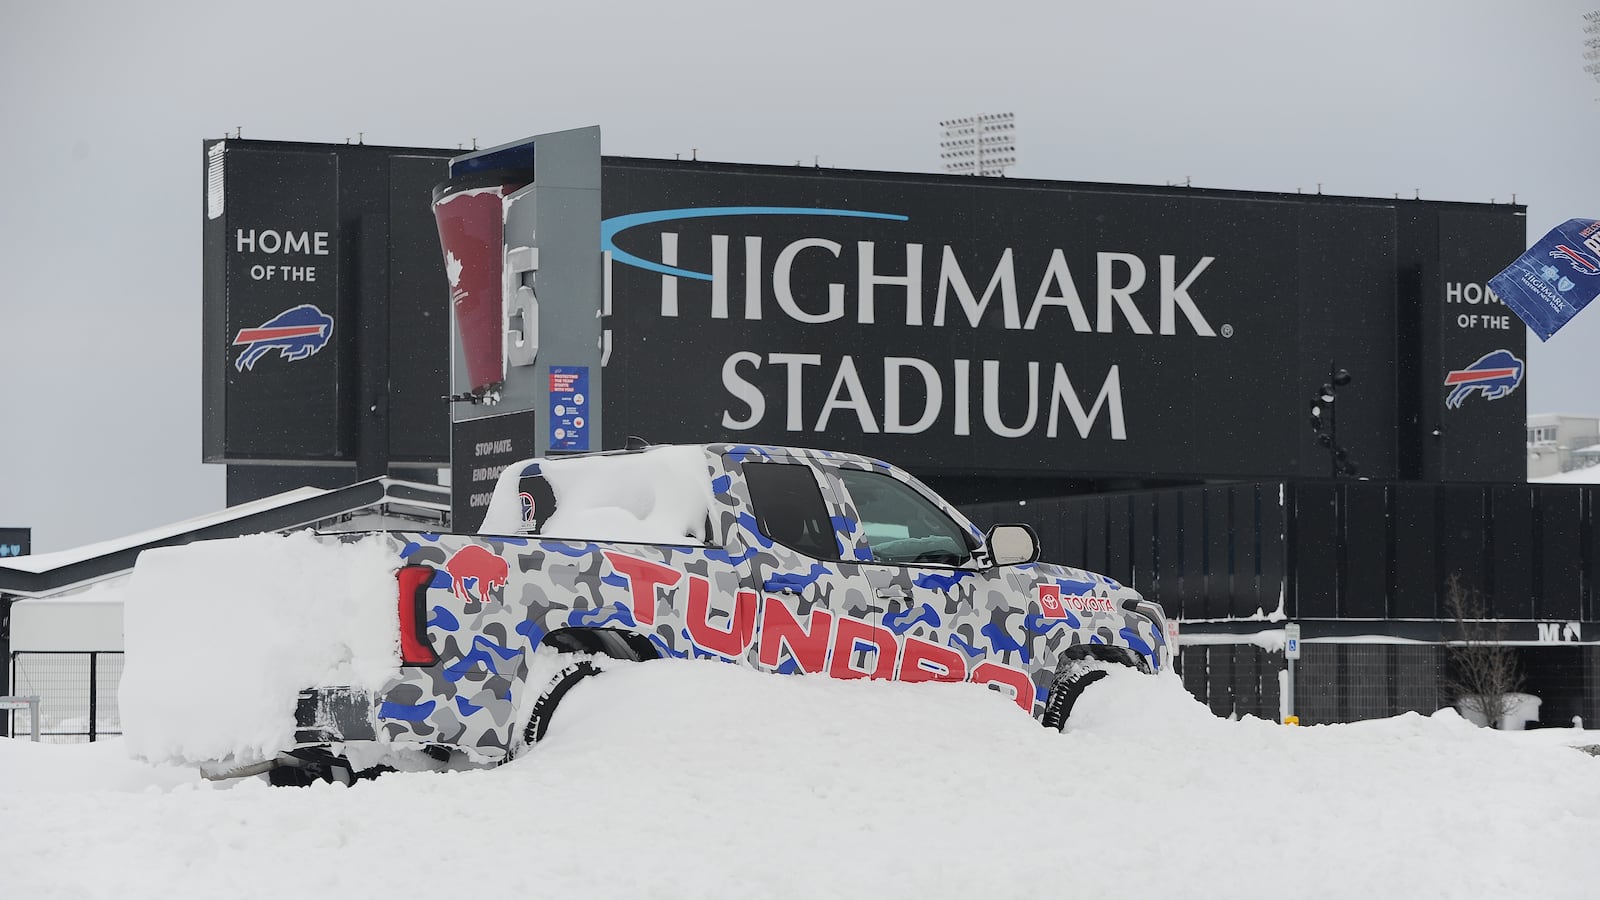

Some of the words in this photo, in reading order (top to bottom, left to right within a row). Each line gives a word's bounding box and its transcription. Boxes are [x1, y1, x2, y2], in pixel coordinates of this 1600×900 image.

[238, 229, 329, 255] HOME
[251, 264, 273, 281] OF
[280, 265, 316, 282] THE
[661, 232, 1217, 337] HIGHMARK
[1447, 282, 1505, 305] HOM
[1524, 270, 1566, 311] HIGHMARK
[1457, 314, 1478, 328] OF
[1481, 315, 1510, 330] THE
[721, 351, 1127, 440] STADIUM
[475, 441, 493, 456] STOP
[493, 439, 512, 454] HATE.
[473, 468, 487, 482] END
[1063, 596, 1116, 613] TOYOTA
